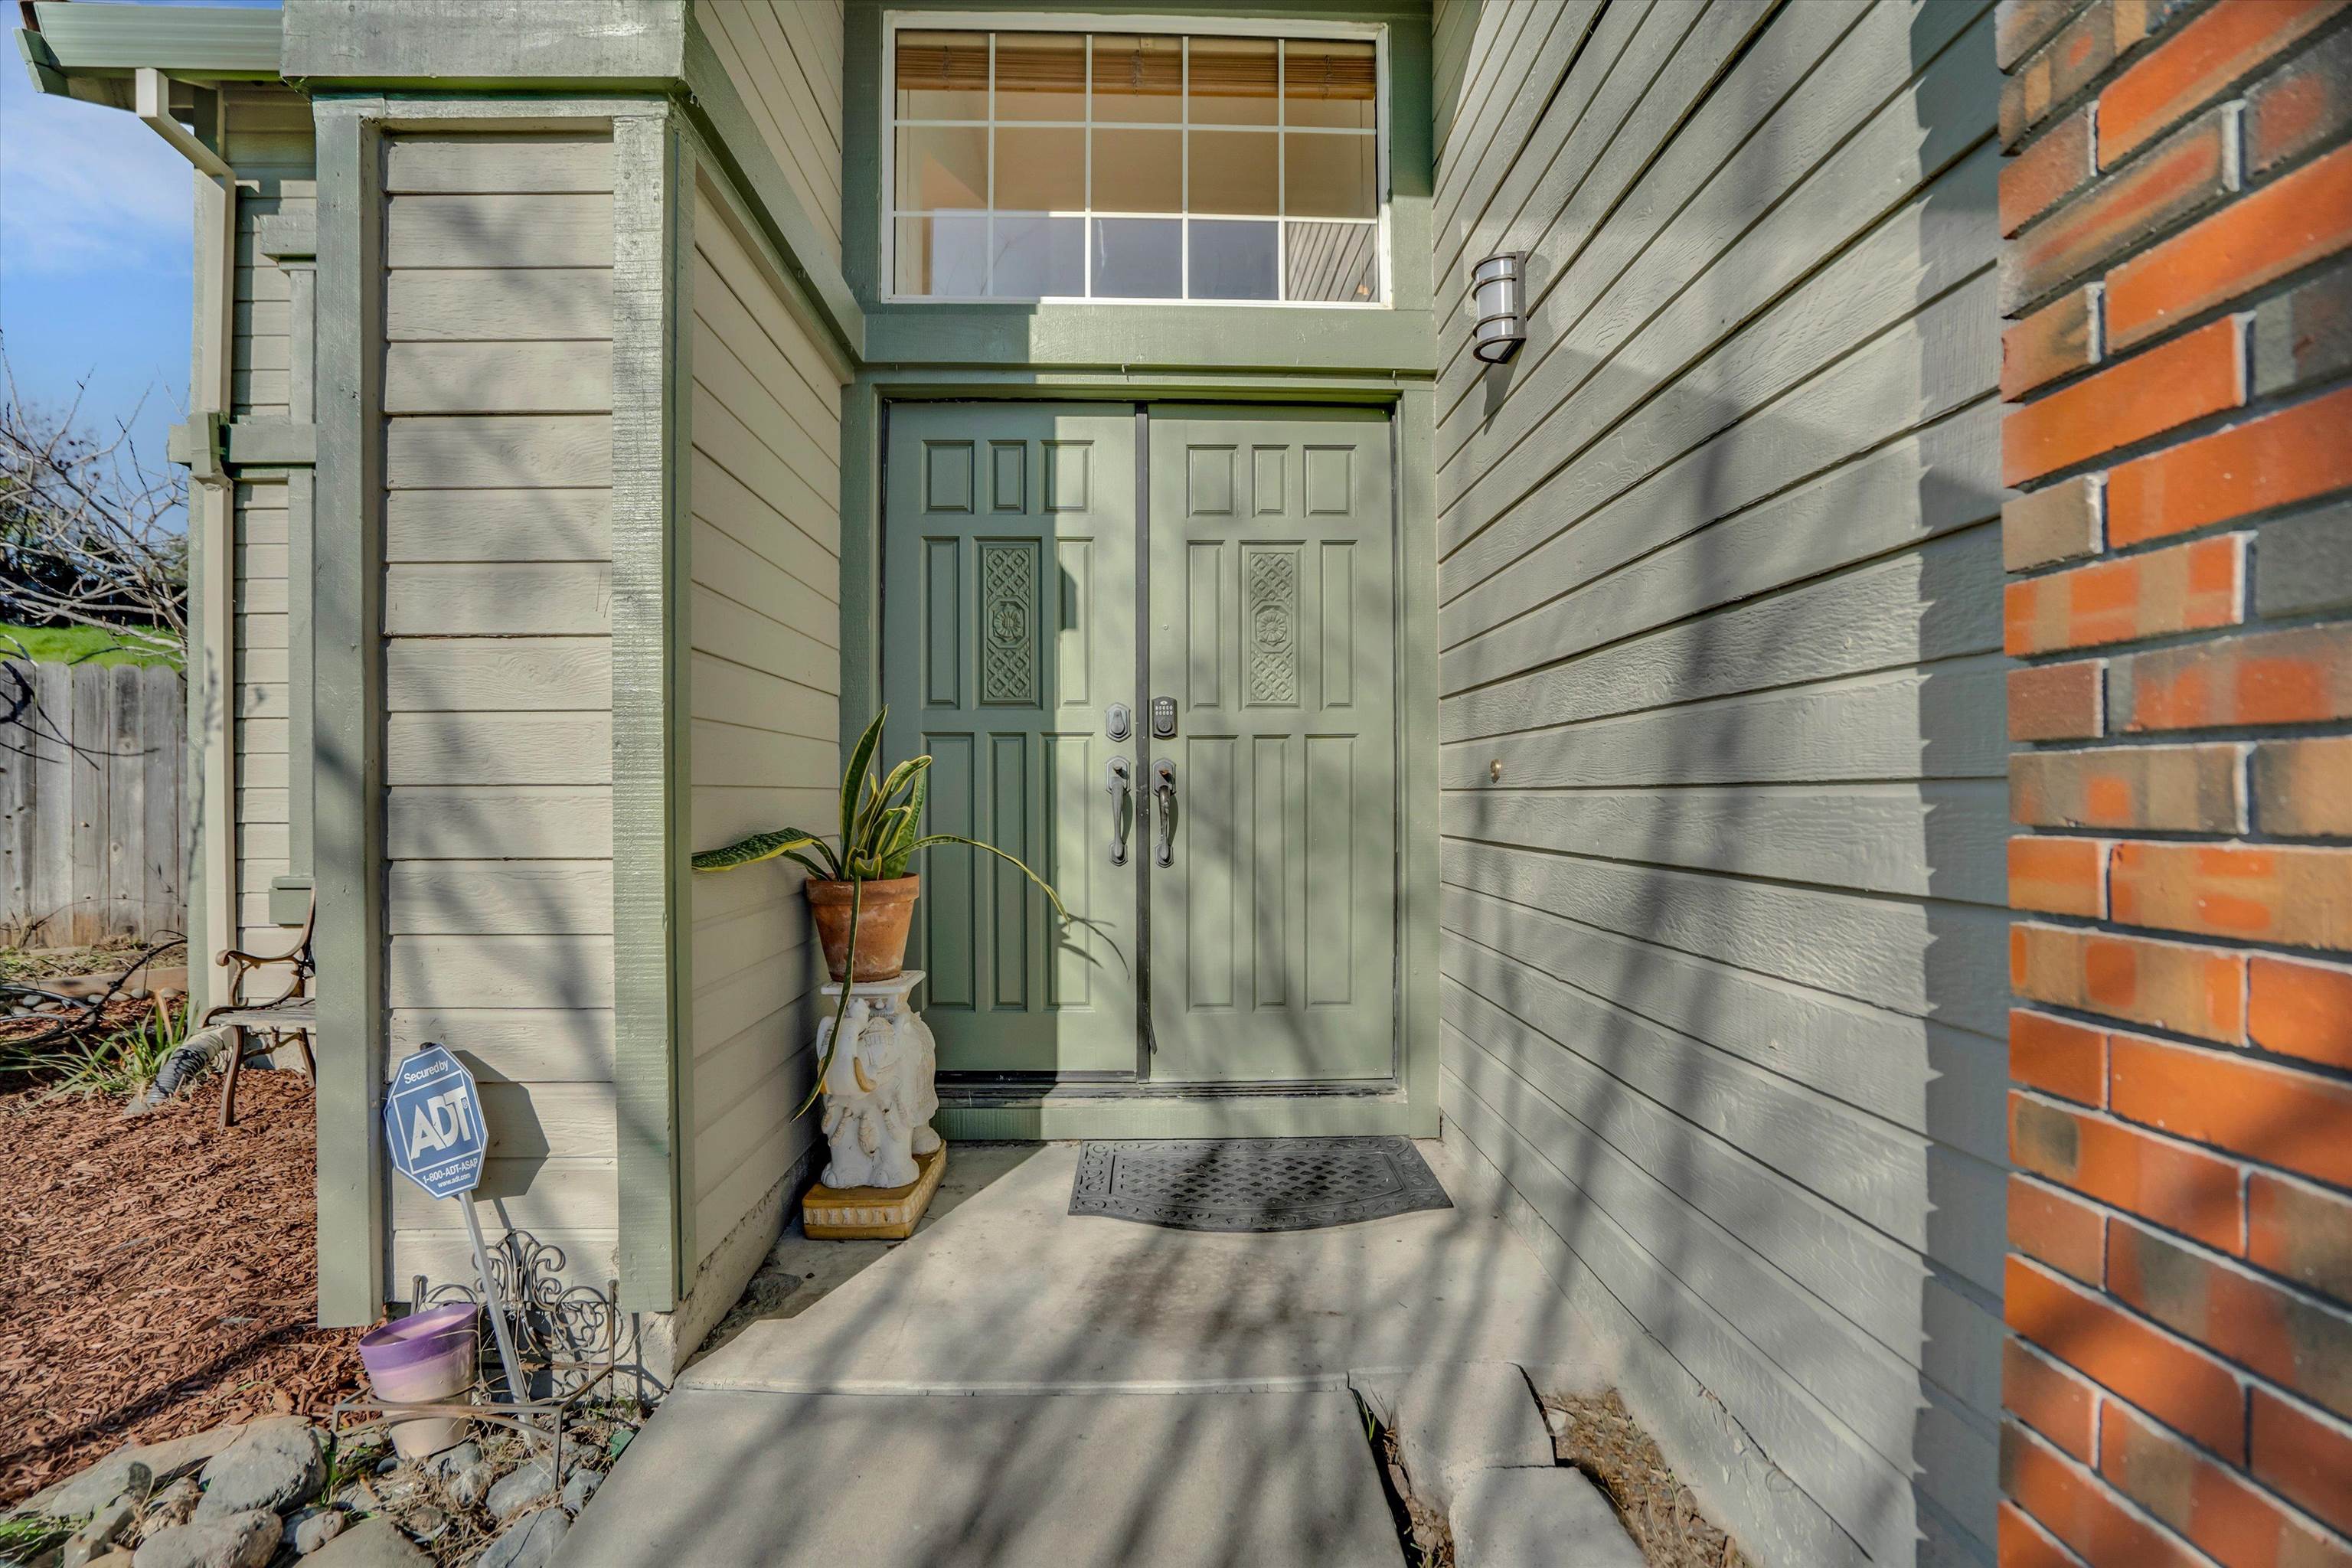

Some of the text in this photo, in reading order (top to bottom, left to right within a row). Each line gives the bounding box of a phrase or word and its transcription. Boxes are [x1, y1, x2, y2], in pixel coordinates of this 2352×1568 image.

[403, 1060, 449, 1084] Secured by
[410, 1086, 471, 1160] ADT
[422, 1158, 478, 1184] 1-800-ADT-ASAP
[437, 1173, 471, 1188] www.adt.com
